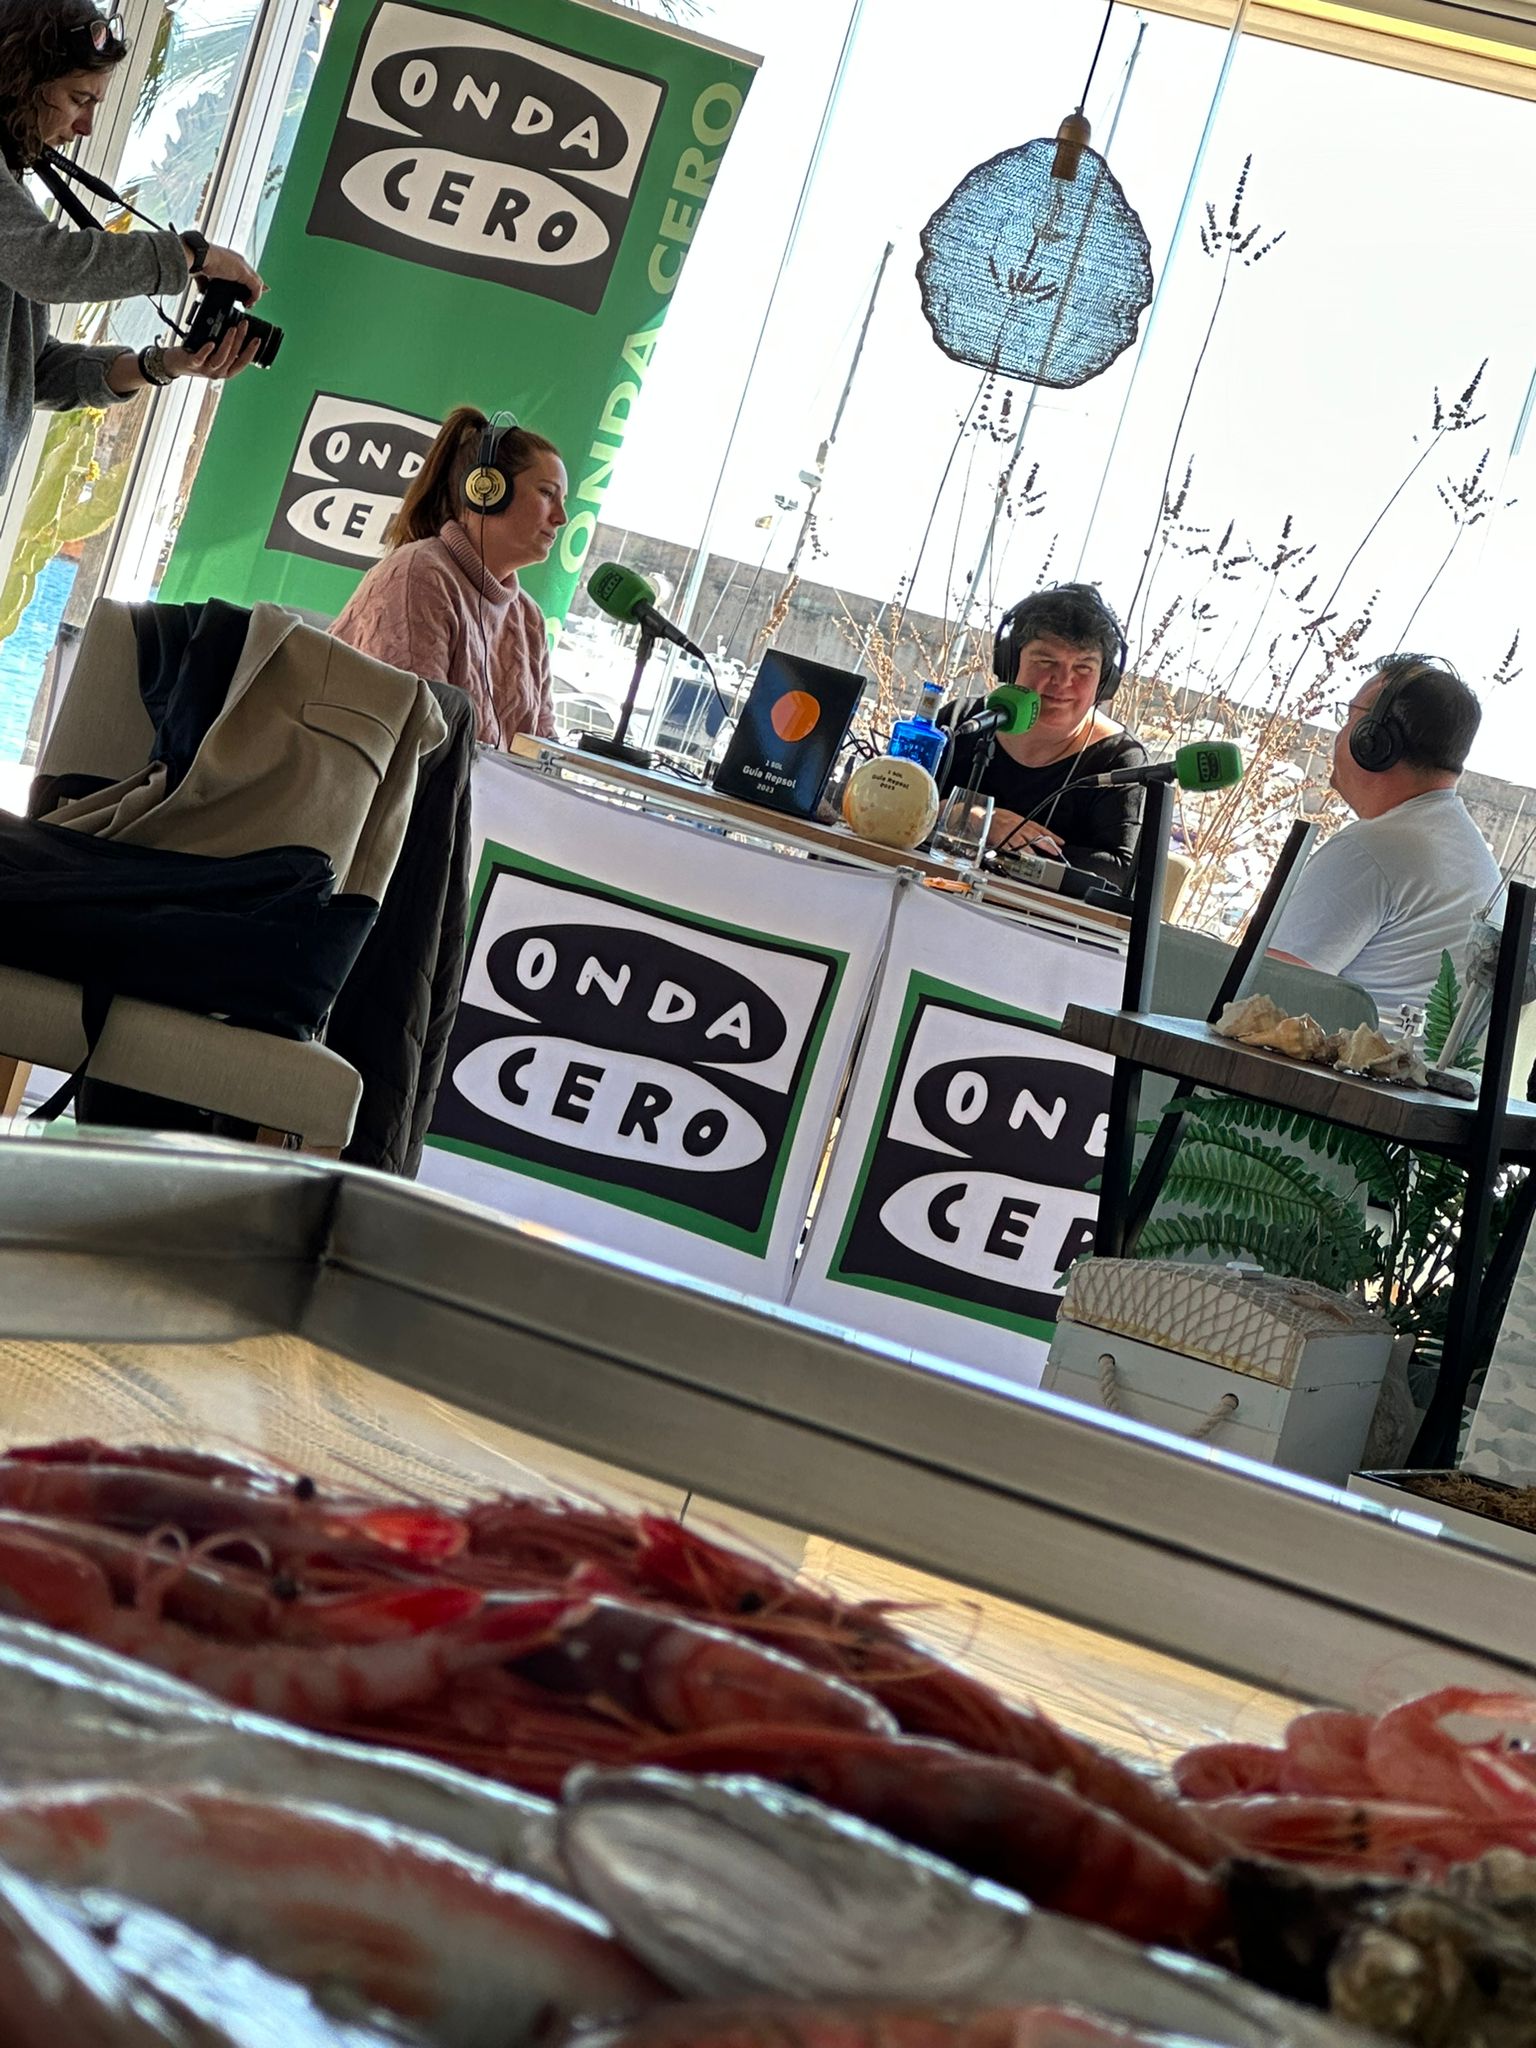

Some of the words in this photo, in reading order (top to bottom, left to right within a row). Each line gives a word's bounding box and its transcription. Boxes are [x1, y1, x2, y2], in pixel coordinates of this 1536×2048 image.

[399, 58, 599, 160] ONDA
[383, 158, 578, 253] CERO
[559, 321, 664, 574] ONDA
[647, 81, 743, 297] CERO
[325, 430, 426, 479] OND
[313, 495, 399, 545] CE
[764, 772, 797, 788] Repsol
[516, 937, 751, 1050] ONDA
[498, 1047, 729, 1157] CERO
[945, 1070, 1110, 1158] ON
[927, 1182, 1098, 1274] CER
